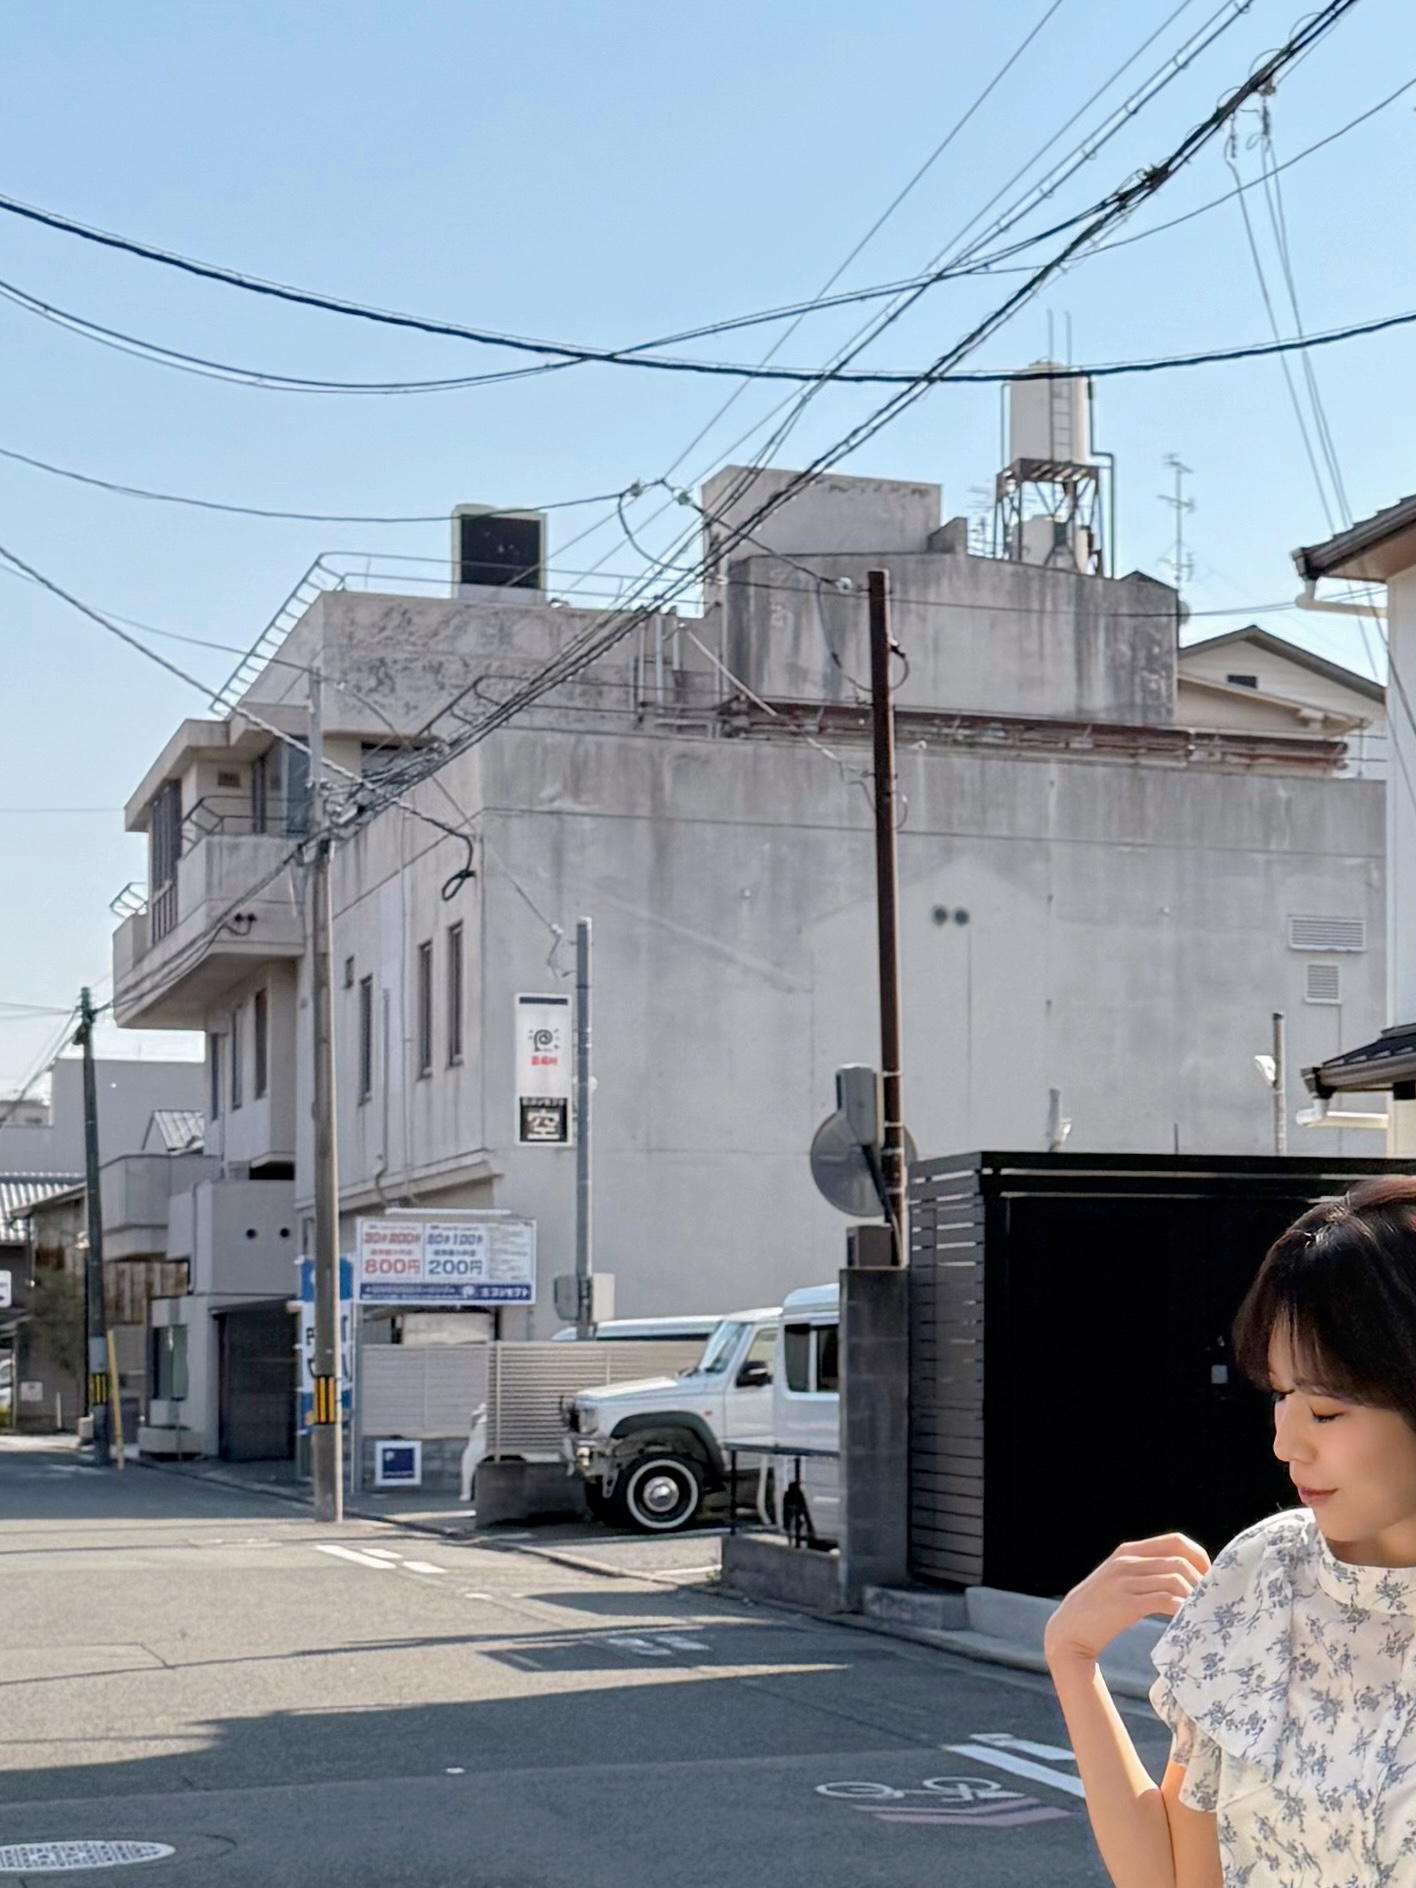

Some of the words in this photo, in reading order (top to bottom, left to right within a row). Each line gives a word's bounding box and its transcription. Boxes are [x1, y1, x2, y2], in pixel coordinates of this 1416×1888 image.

[527, 1109, 560, 1140] 空
[364, 1259, 421, 1275] 800円
[428, 1259, 483, 1275] 200円
